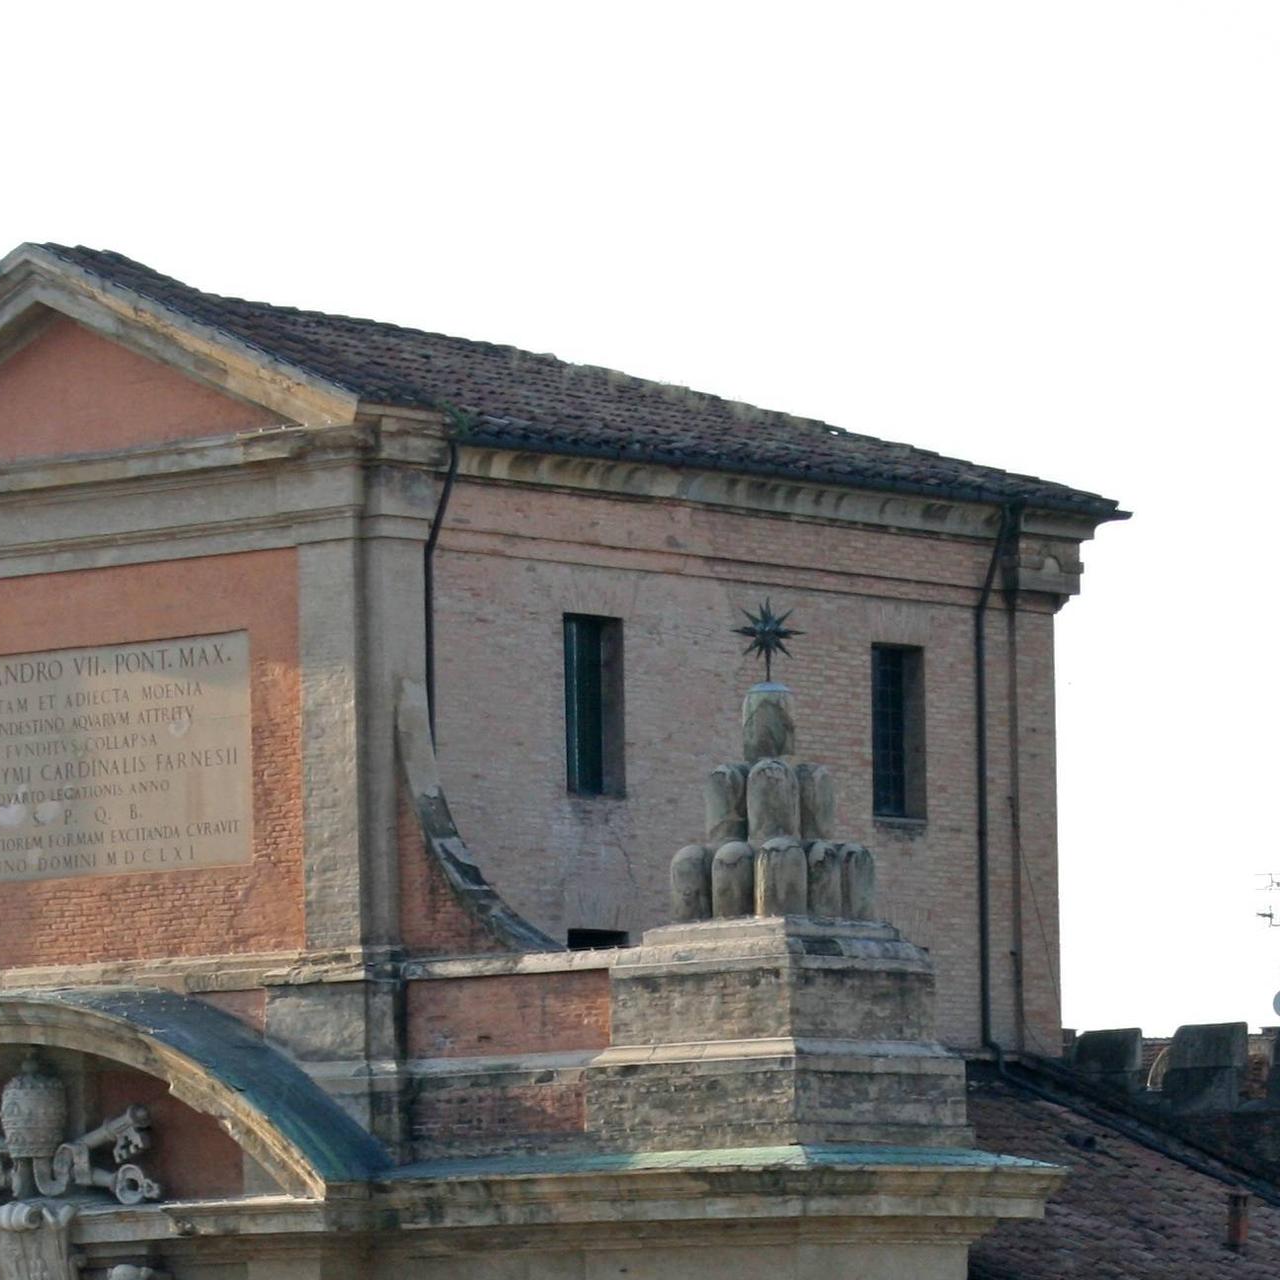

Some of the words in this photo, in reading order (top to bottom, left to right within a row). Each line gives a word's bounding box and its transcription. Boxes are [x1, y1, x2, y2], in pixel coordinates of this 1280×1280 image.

[73, 655, 106, 677] VII.
[115, 649, 173, 674] PONT.
[179, 643, 232, 669] MAX.
[39, 694, 56, 711] ET
[142, 681, 203, 701] MOENIA
[84, 733, 158, 753] COLLAPSA
[40, 756, 147, 782] CARDINALIS
[156, 747, 238, 773] FARNESII
[130, 779, 170, 795] ANNO
[49, 831, 105, 849] FORMAM
[110, 825, 180, 844] EXCITANDA
[186, 819, 240, 838] CVRAVIT
[38, 853, 97, 873] DOMINI
